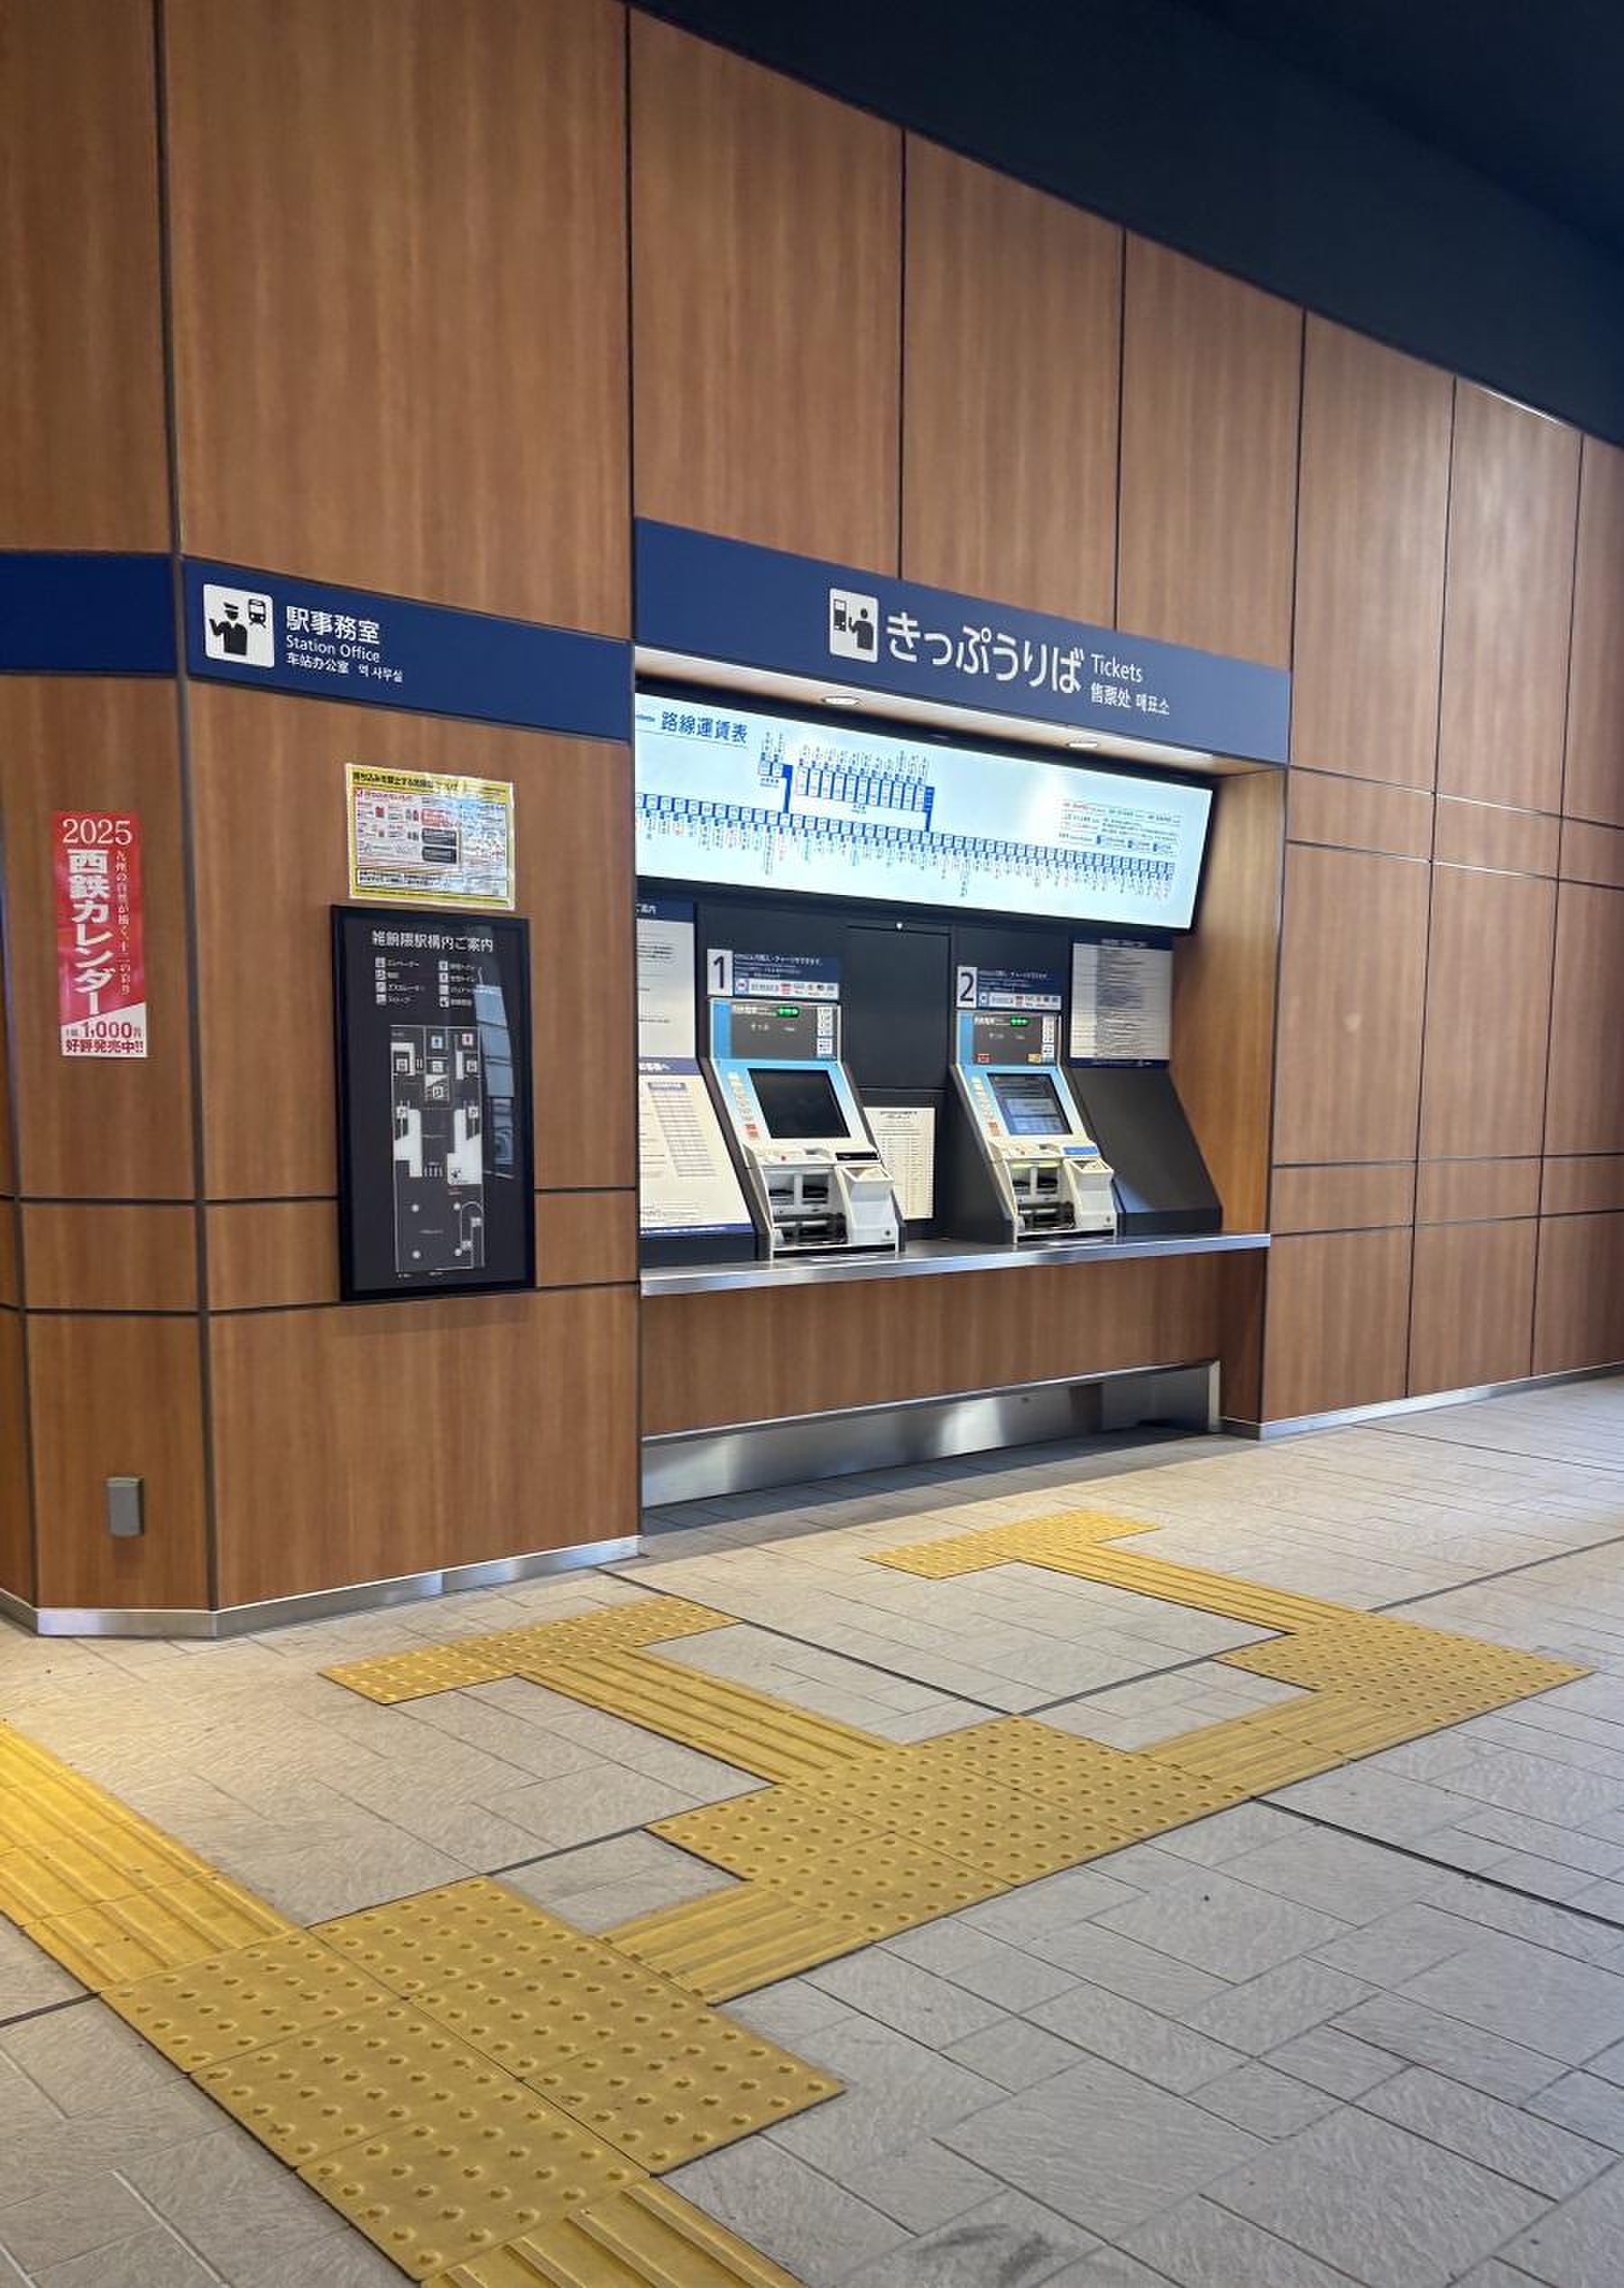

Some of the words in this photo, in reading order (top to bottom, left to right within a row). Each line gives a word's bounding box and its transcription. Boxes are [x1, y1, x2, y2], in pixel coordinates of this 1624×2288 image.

[286, 605, 380, 645] 駅事務室
[286, 634, 336, 655] Station
[340, 643, 380, 663] Office
[286, 652, 349, 674] 车站办公室
[885, 612, 1084, 694] きっぷうりば
[1090, 653, 1143, 683] Tickets
[1091, 682, 1132, 708] 售票处
[1136, 693, 1170, 715] 매표소
[62, 817, 133, 845] 2025
[67, 848, 115, 1016] 西鉄カレンダー
[713, 955, 724, 990] 1
[960, 972, 974, 1002] 2
